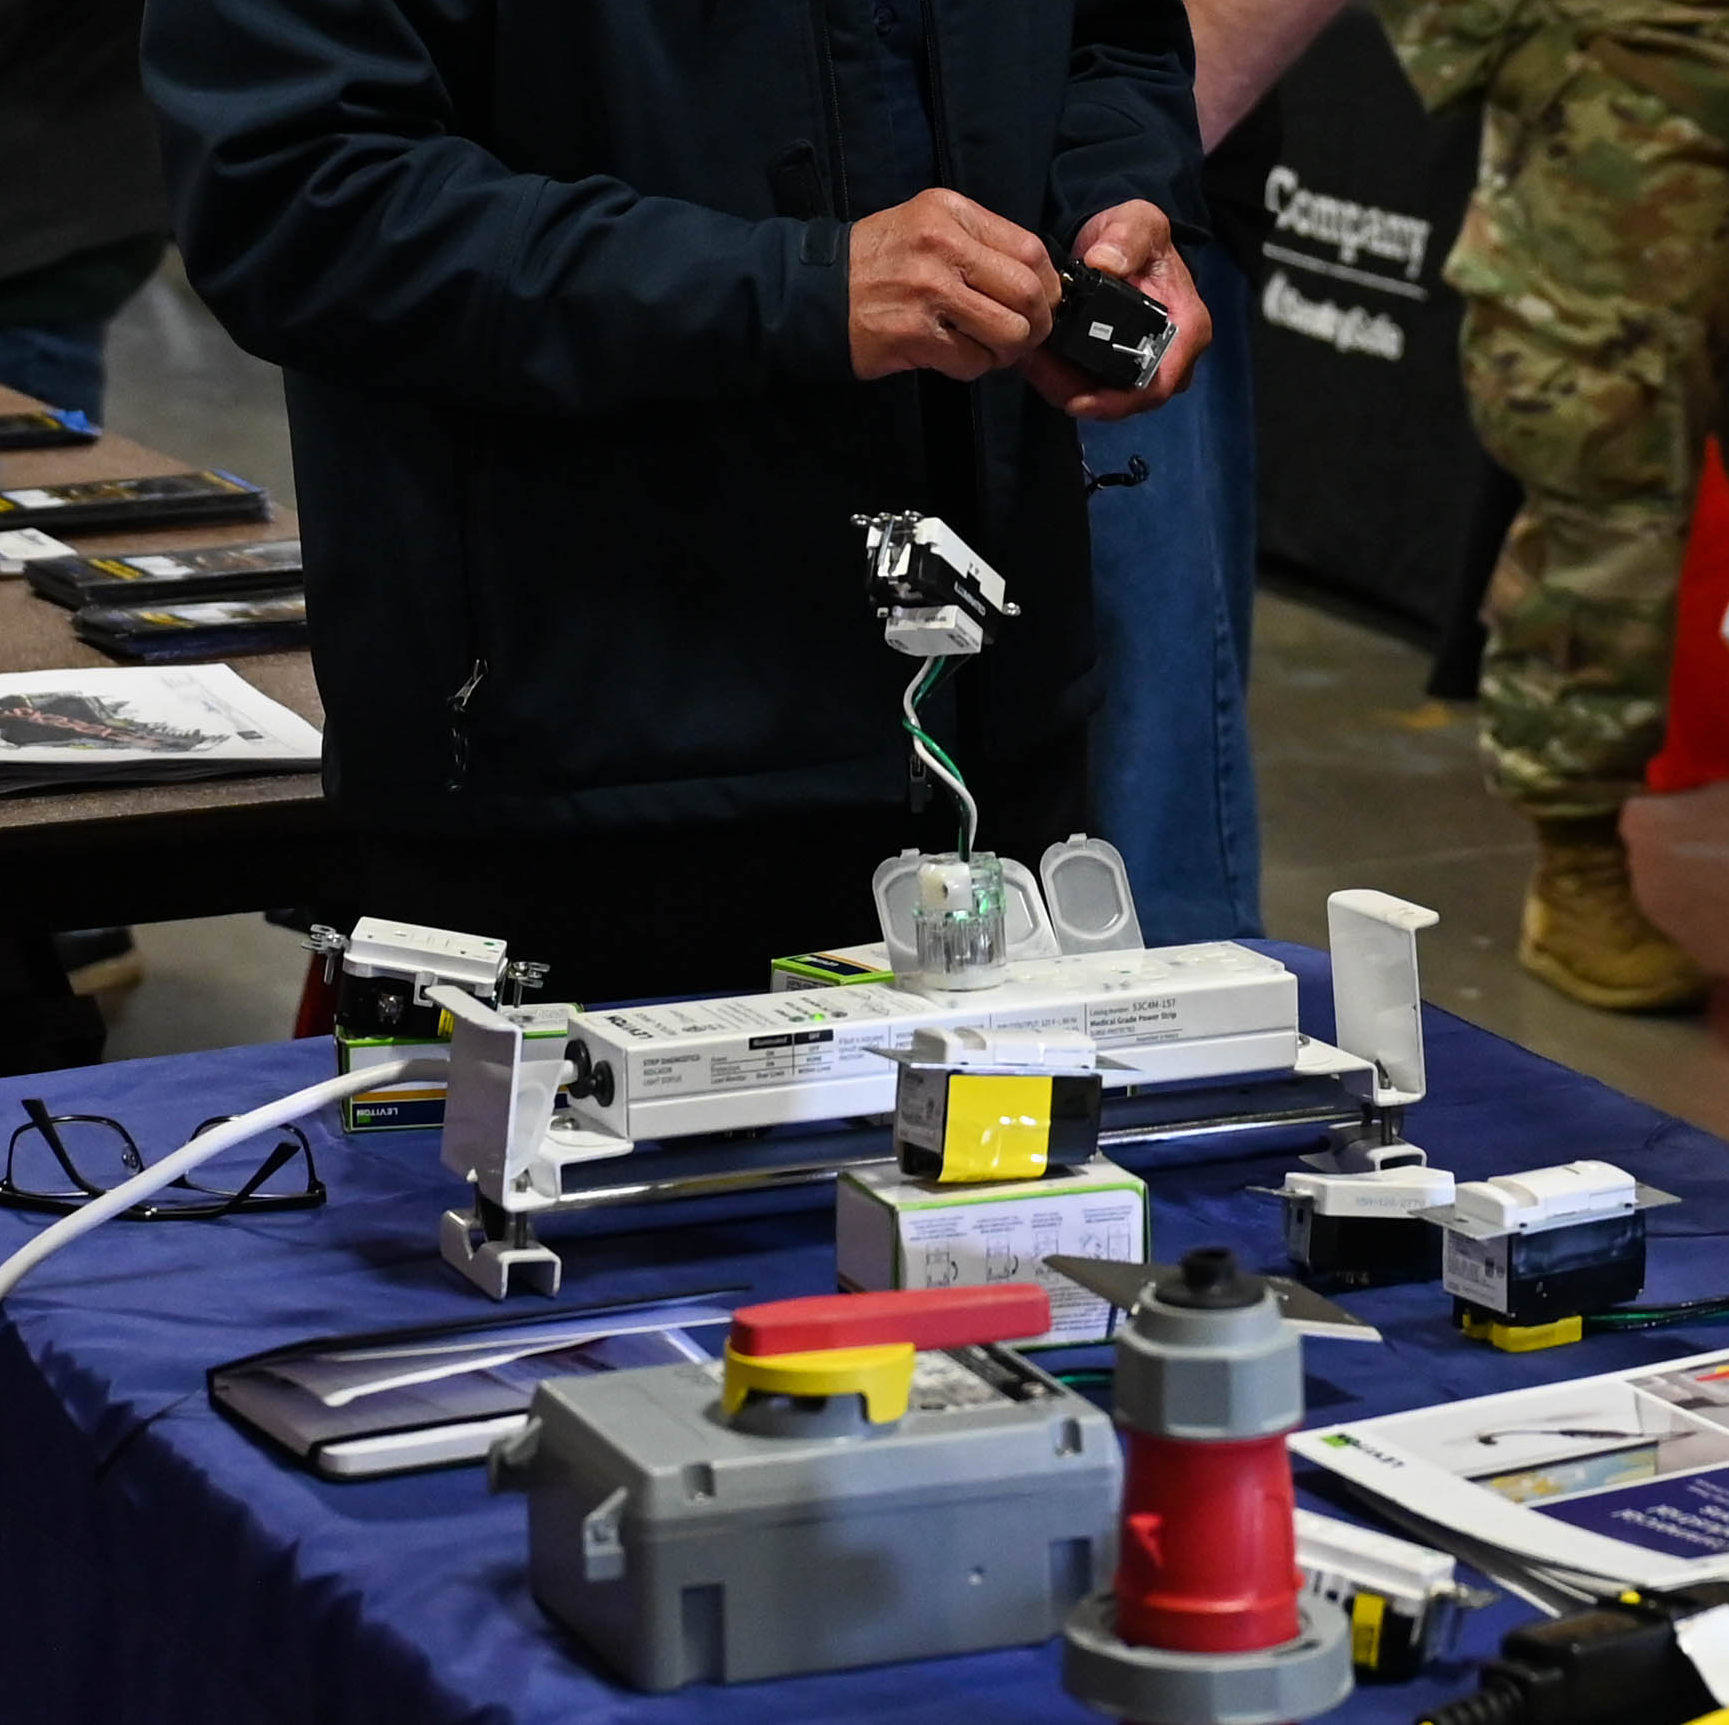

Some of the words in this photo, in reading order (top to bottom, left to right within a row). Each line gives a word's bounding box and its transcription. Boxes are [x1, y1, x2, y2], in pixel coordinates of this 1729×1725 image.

[1264, 165, 1430, 280] Company
[1090, 1017, 1116, 1027] Medical
[1117, 1016, 1137, 1025] Grade
[1138, 1013, 1159, 1022] Power
[1160, 1011, 1177, 1021] Strip
[357, 1107, 399, 1117] LEVITON
